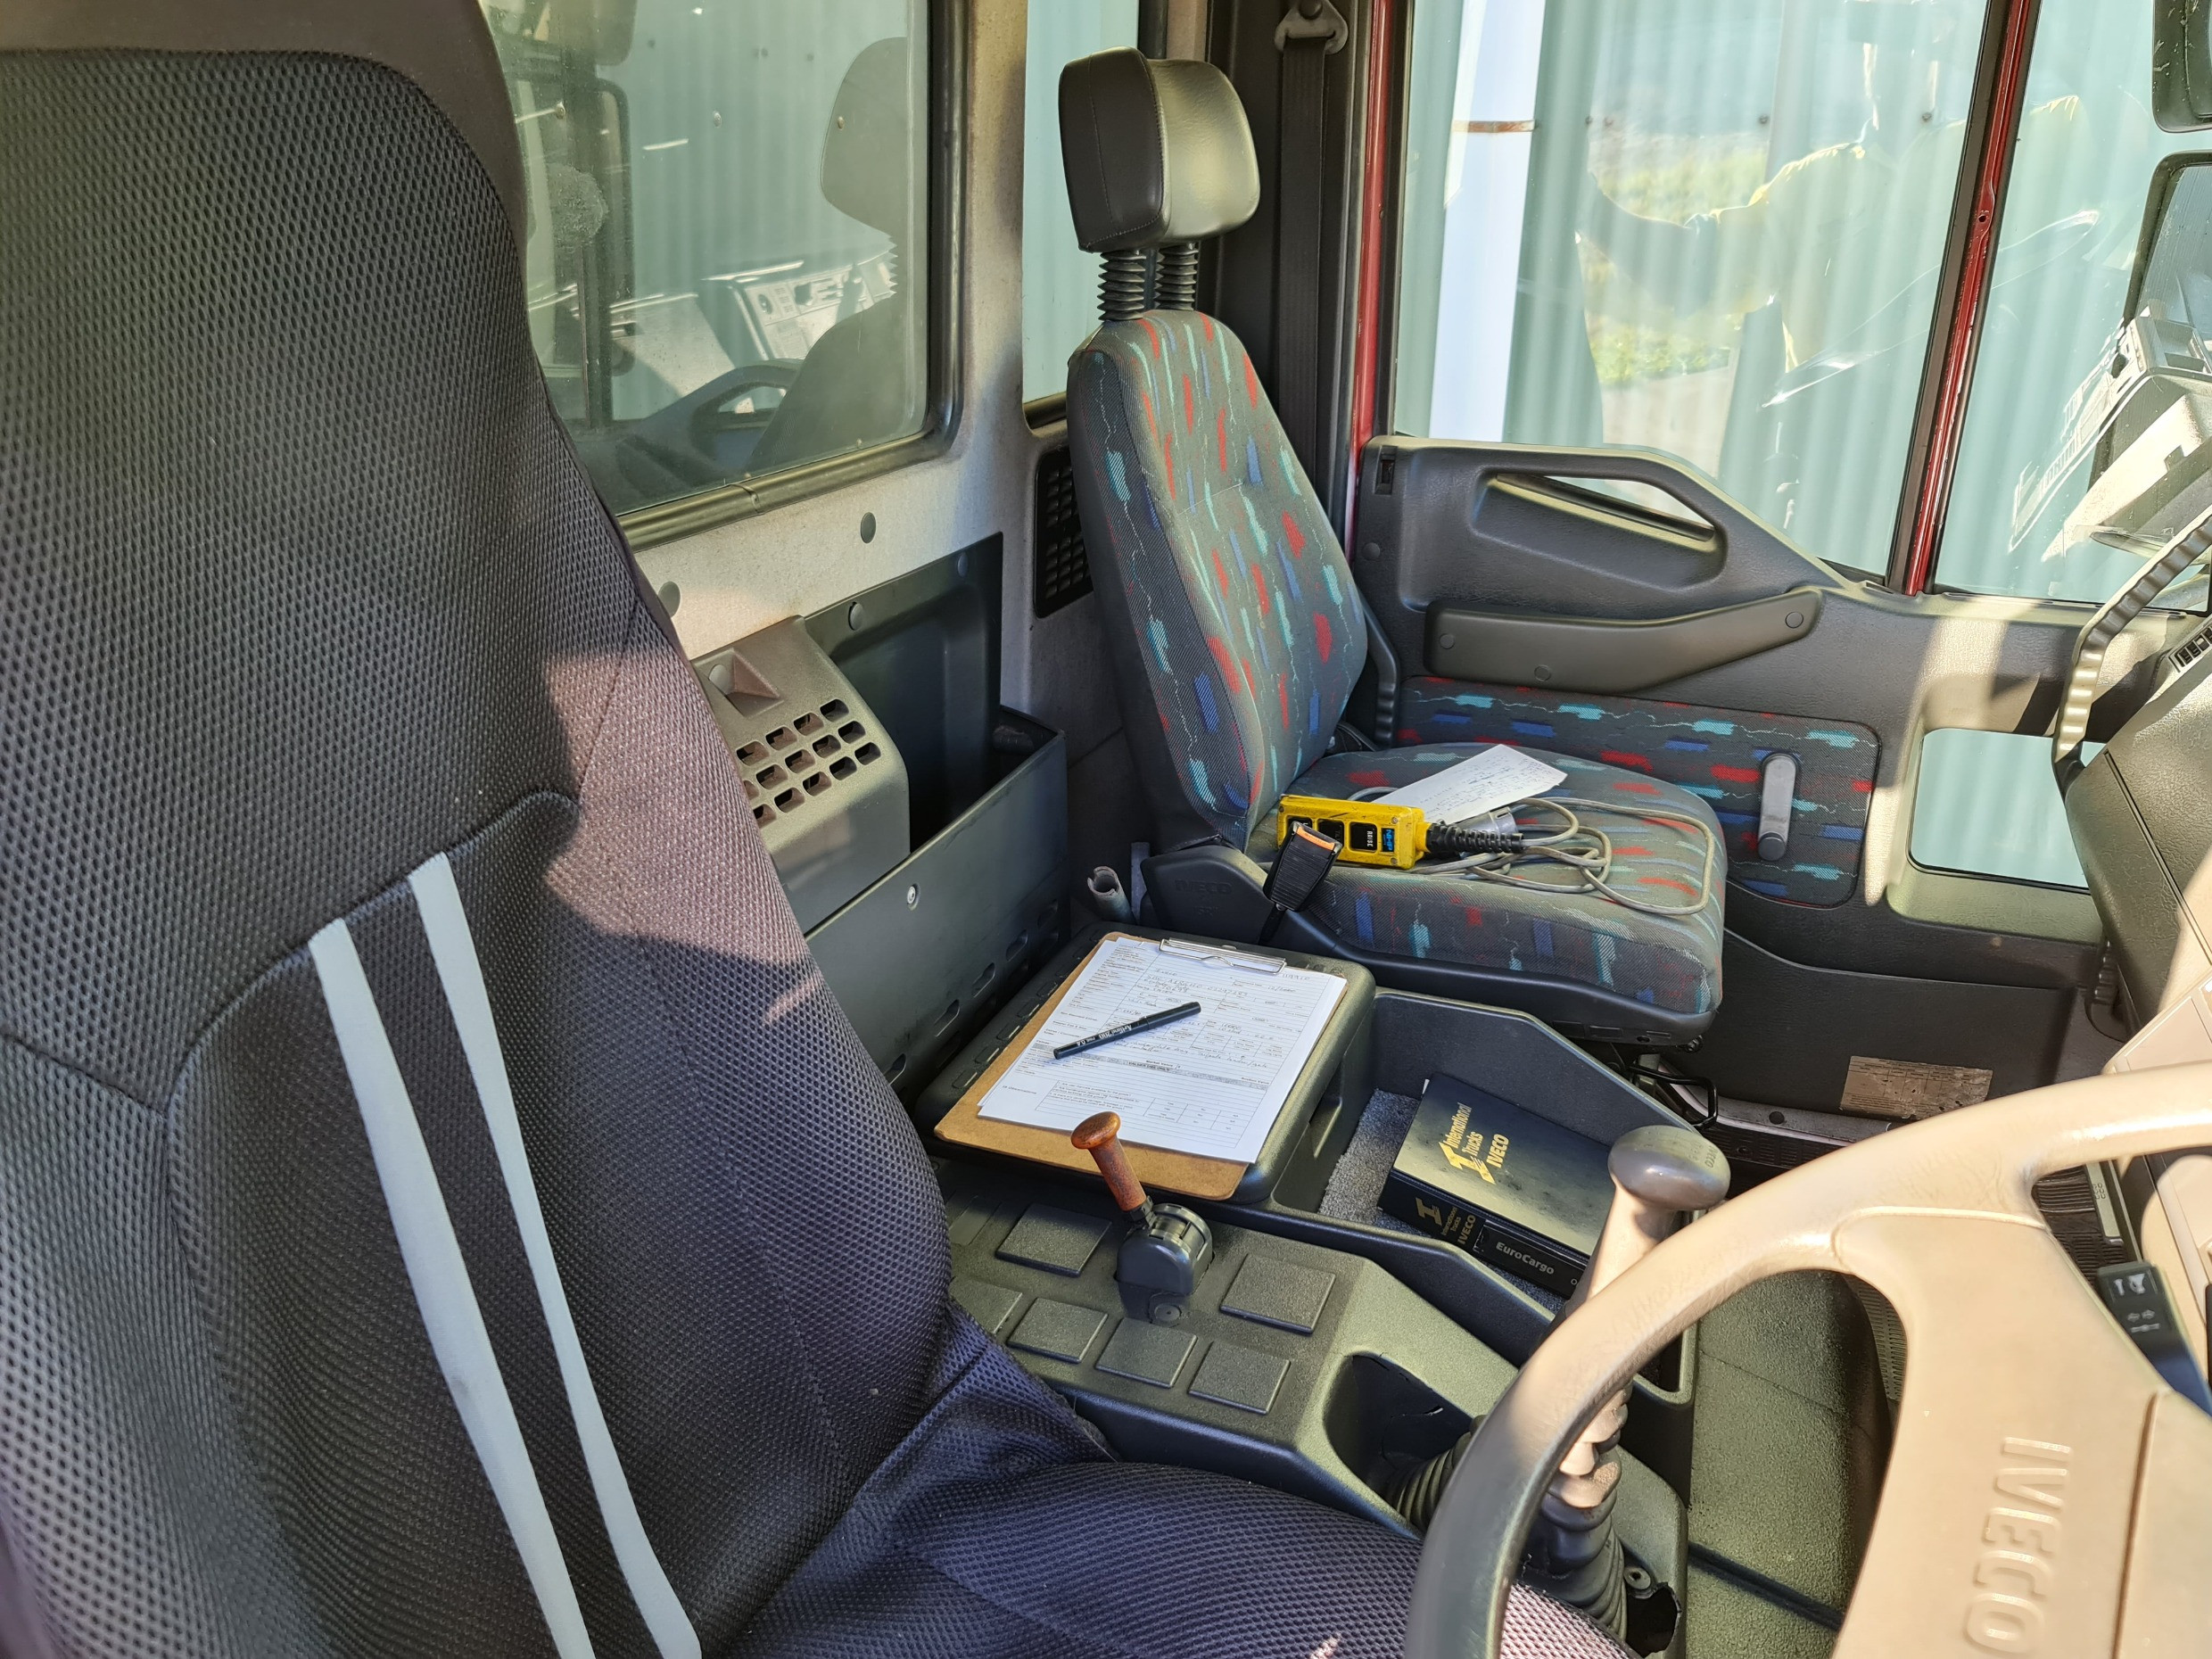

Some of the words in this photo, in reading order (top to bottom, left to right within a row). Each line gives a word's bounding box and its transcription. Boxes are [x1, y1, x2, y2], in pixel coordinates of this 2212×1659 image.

[1442, 1102, 1472, 1149] International
[1461, 1131, 1483, 1157] Trucks
[1486, 1134, 1509, 1168] IVECO
[1457, 1214, 1476, 1245] IVECO
[1495, 1241, 1555, 1275] EuroCargo
[1962, 1436, 2074, 1657] IVECO
